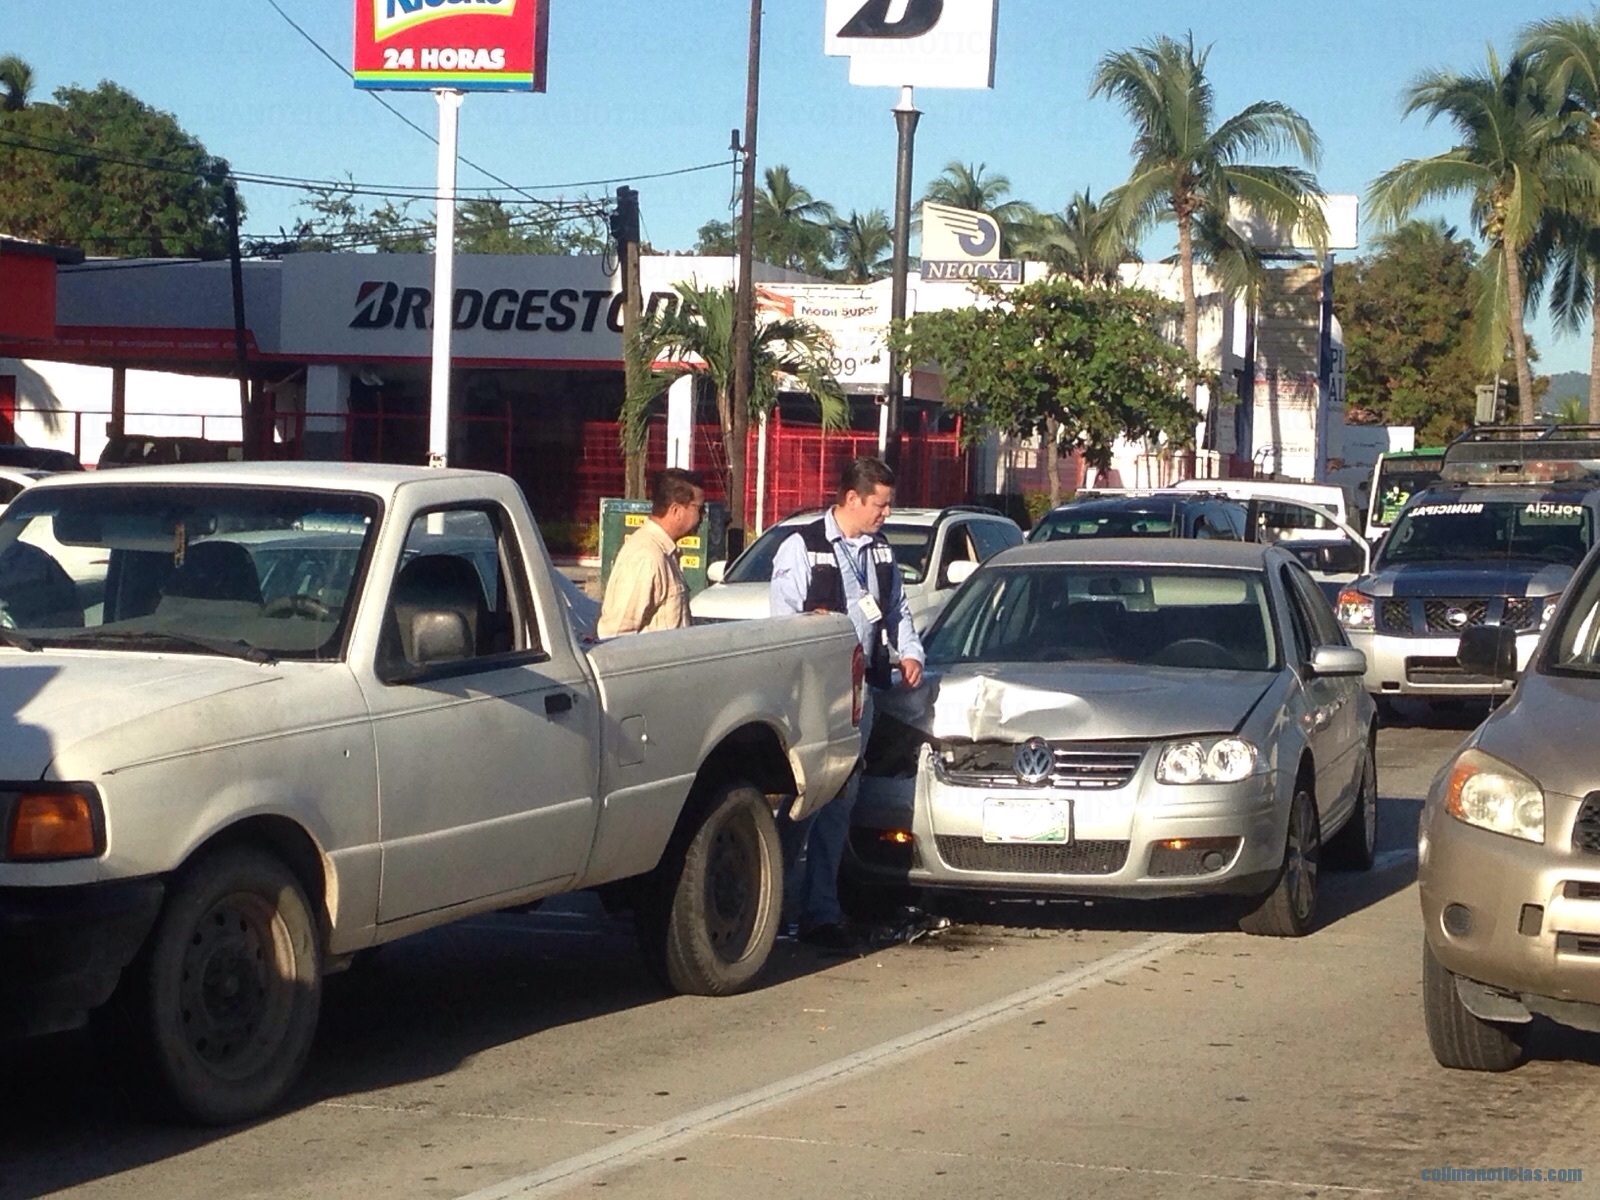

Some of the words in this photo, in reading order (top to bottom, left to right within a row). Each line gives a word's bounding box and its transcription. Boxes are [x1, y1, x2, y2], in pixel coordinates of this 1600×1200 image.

[383, 47, 416, 70] 24
[420, 47, 506, 71] HORAS
[927, 262, 1014, 280] NEOCSA
